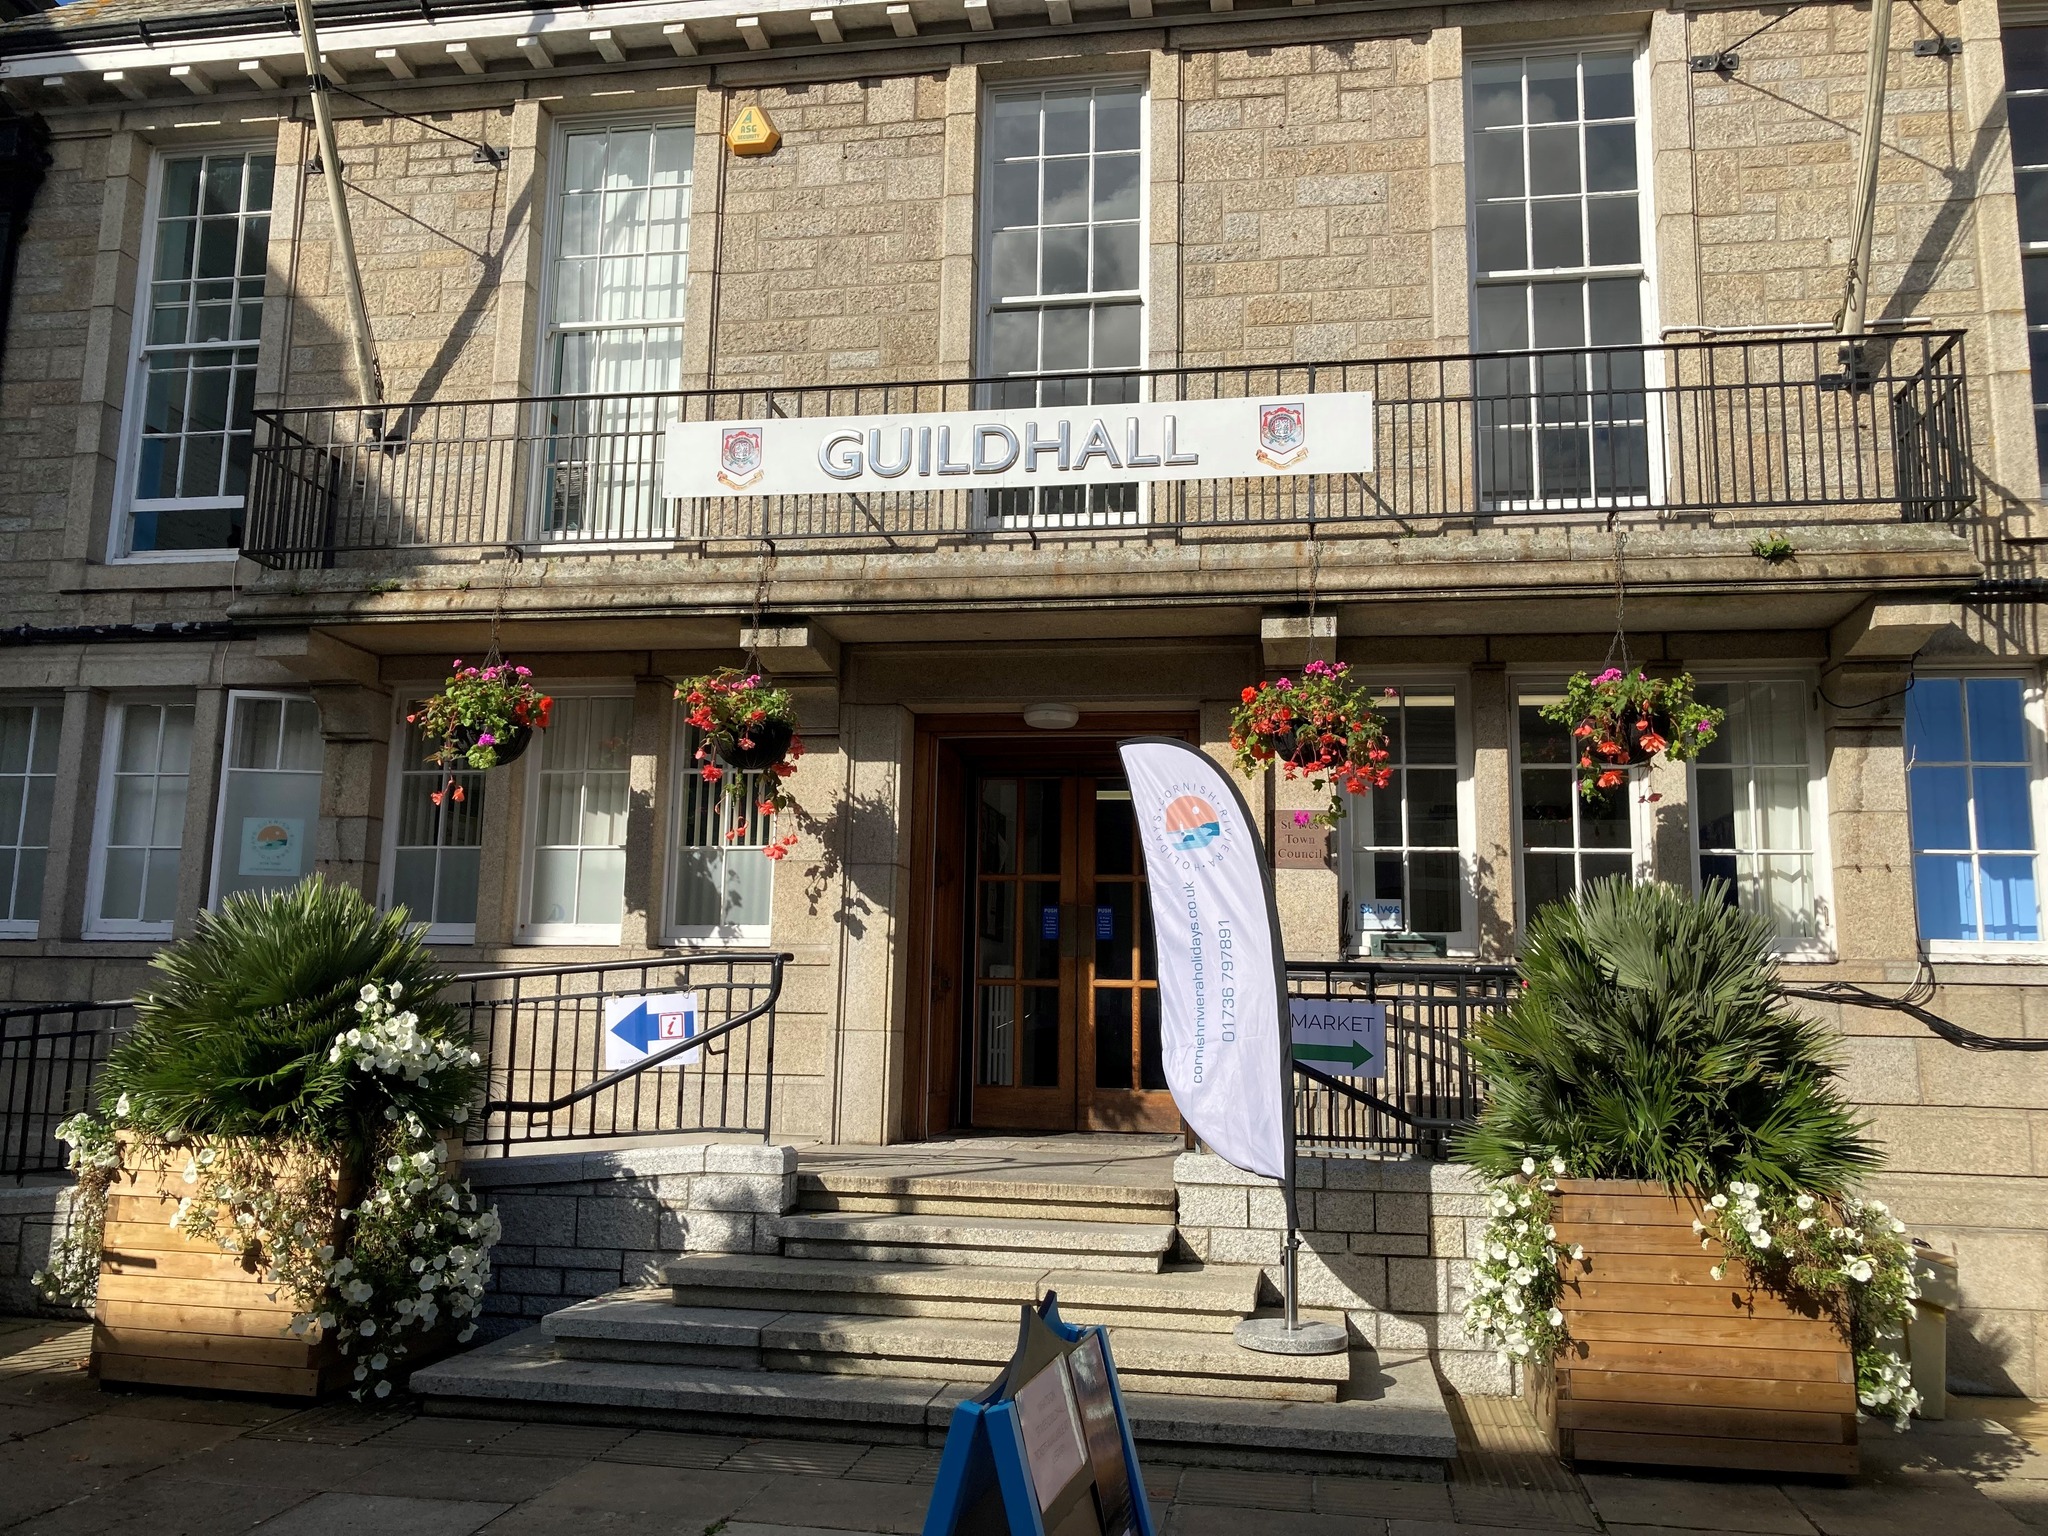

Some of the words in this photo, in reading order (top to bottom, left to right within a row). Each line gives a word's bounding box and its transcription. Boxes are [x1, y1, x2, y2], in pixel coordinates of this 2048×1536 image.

[740, 124, 757, 134] ASG
[818, 415, 1199, 480] GUILDHALL
[1158, 782, 1217, 806] CORNISH
[1152, 814, 1201, 871] HOLIDAYS
[1208, 808, 1233, 868] RIVIERA
[1281, 820, 1291, 830] St
[1285, 834, 1315, 844] Town
[1278, 848, 1322, 859] Council
[1218, 919, 1234, 982] 797891
[1183, 880, 1206, 1084] cornishrivieraholidays.co.uk
[1221, 987, 1235, 1042] 01736
[1291, 1013, 1375, 1032] MARKET
